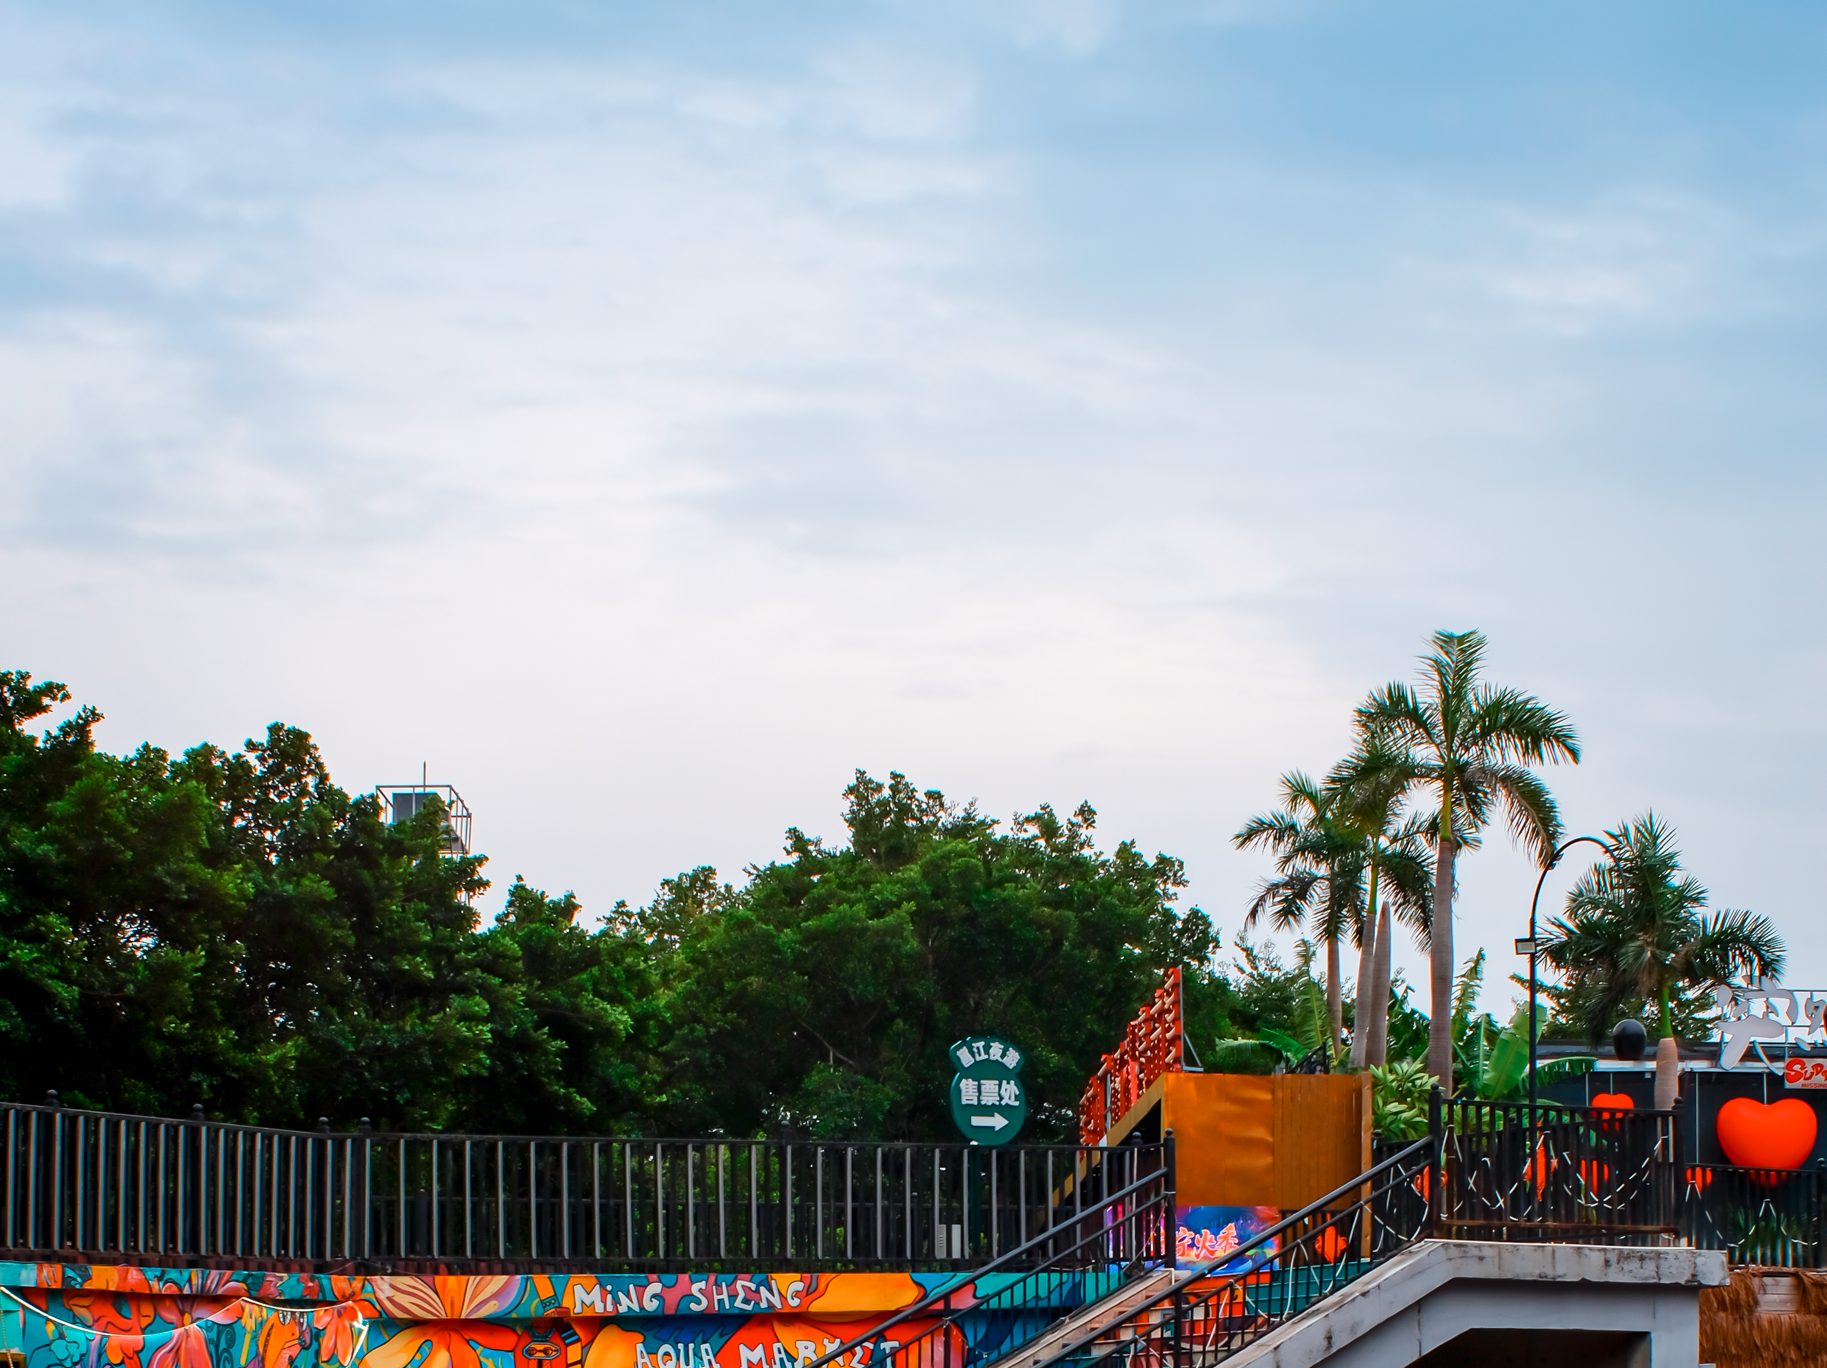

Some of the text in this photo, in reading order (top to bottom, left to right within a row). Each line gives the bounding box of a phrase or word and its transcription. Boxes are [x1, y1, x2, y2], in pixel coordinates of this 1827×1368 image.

[960, 1078, 1020, 1106] 售票处
[689, 1276, 805, 1312] SHENG
